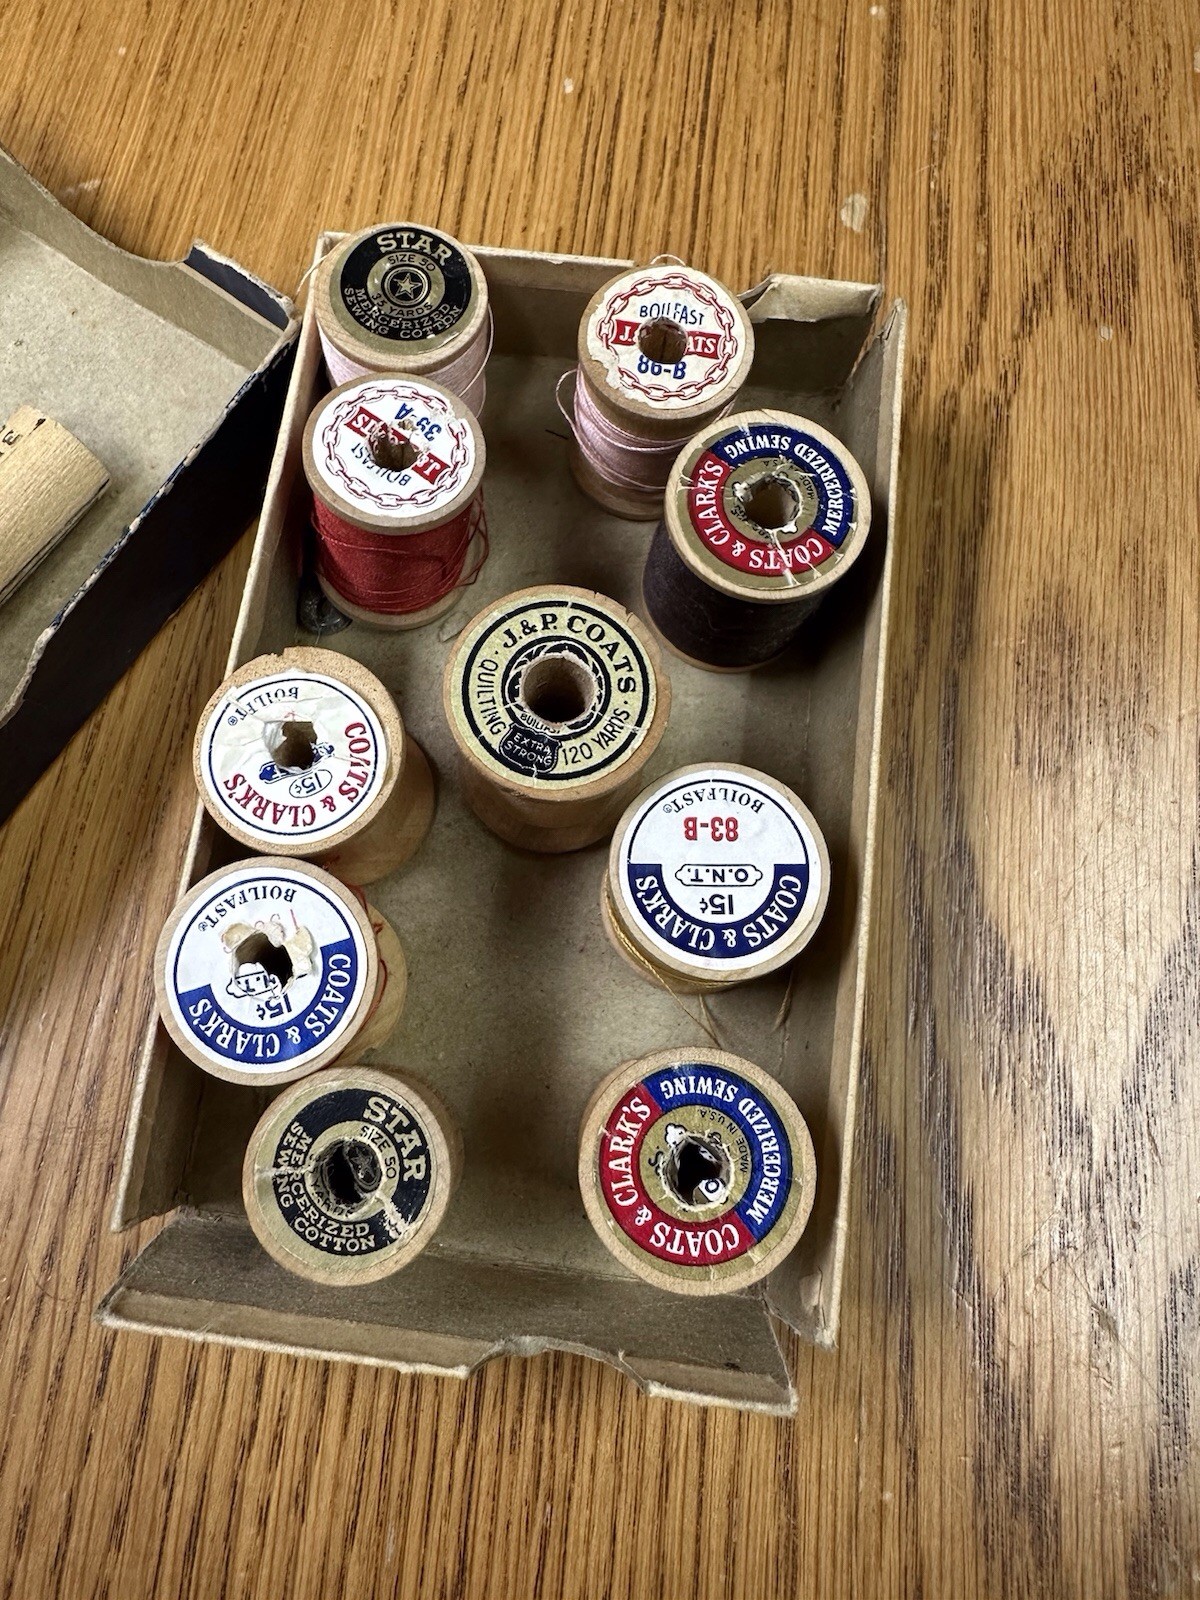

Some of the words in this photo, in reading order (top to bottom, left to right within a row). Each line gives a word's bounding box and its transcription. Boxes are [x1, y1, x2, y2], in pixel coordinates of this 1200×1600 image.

[377, 231, 453, 265] STAR
[388, 253, 416, 265] SIZE
[419, 258, 436, 272] 50
[345, 287, 389, 334] SEWING
[400, 305, 461, 338] COTTON
[356, 288, 450, 329] MERCERIZED
[372, 293, 386, 307] 35
[389, 302, 433, 316] YARDS
[637, 355, 687, 379] 86-B
[724, 435, 791, 459] SEWING
[696, 460, 731, 545] CLARK'S
[794, 443, 843, 535] MERCERIZED
[732, 540, 746, 557] &
[749, 538, 823, 569] COATS
[503, 614, 558, 648] J.&P.
[567, 616, 636, 693] COATS
[478, 659, 506, 735] QUILTING
[504, 741, 552, 766] STRONG
[513, 734, 551, 754] EXTRA
[562, 743, 592, 765] 120
[593, 708, 630, 750] YARDS
[295, 771, 322, 794] 15¢
[224, 773, 316, 827] CLARK'S
[321, 795, 337, 812] &
[684, 817, 738, 841] 83-B
[688, 868, 749, 882] O.N.T.
[635, 875, 715, 950] CLARK'S
[700, 894, 734, 915] 15¢
[743, 874, 801, 947] COATS
[722, 929, 736, 947] &
[256, 994, 292, 1020] 15¢
[305, 954, 351, 1038] COATS
[189, 998, 280, 1058] CLARK'S
[285, 1025, 301, 1044] &
[660, 1076, 738, 1103] SEWING
[363, 1096, 426, 1181] STAR
[728, 1123, 737, 1134] IN
[361, 1125, 390, 1153] SIZE
[385, 1157, 396, 1179] 50
[609, 1097, 651, 1207] CLARK'S
[736, 1137, 748, 1174] MADE
[738, 1097, 781, 1225] MERCERIZED
[635, 1205, 652, 1226] &
[294, 1217, 376, 1252] COTTON
[649, 1222, 739, 1257] COATS
